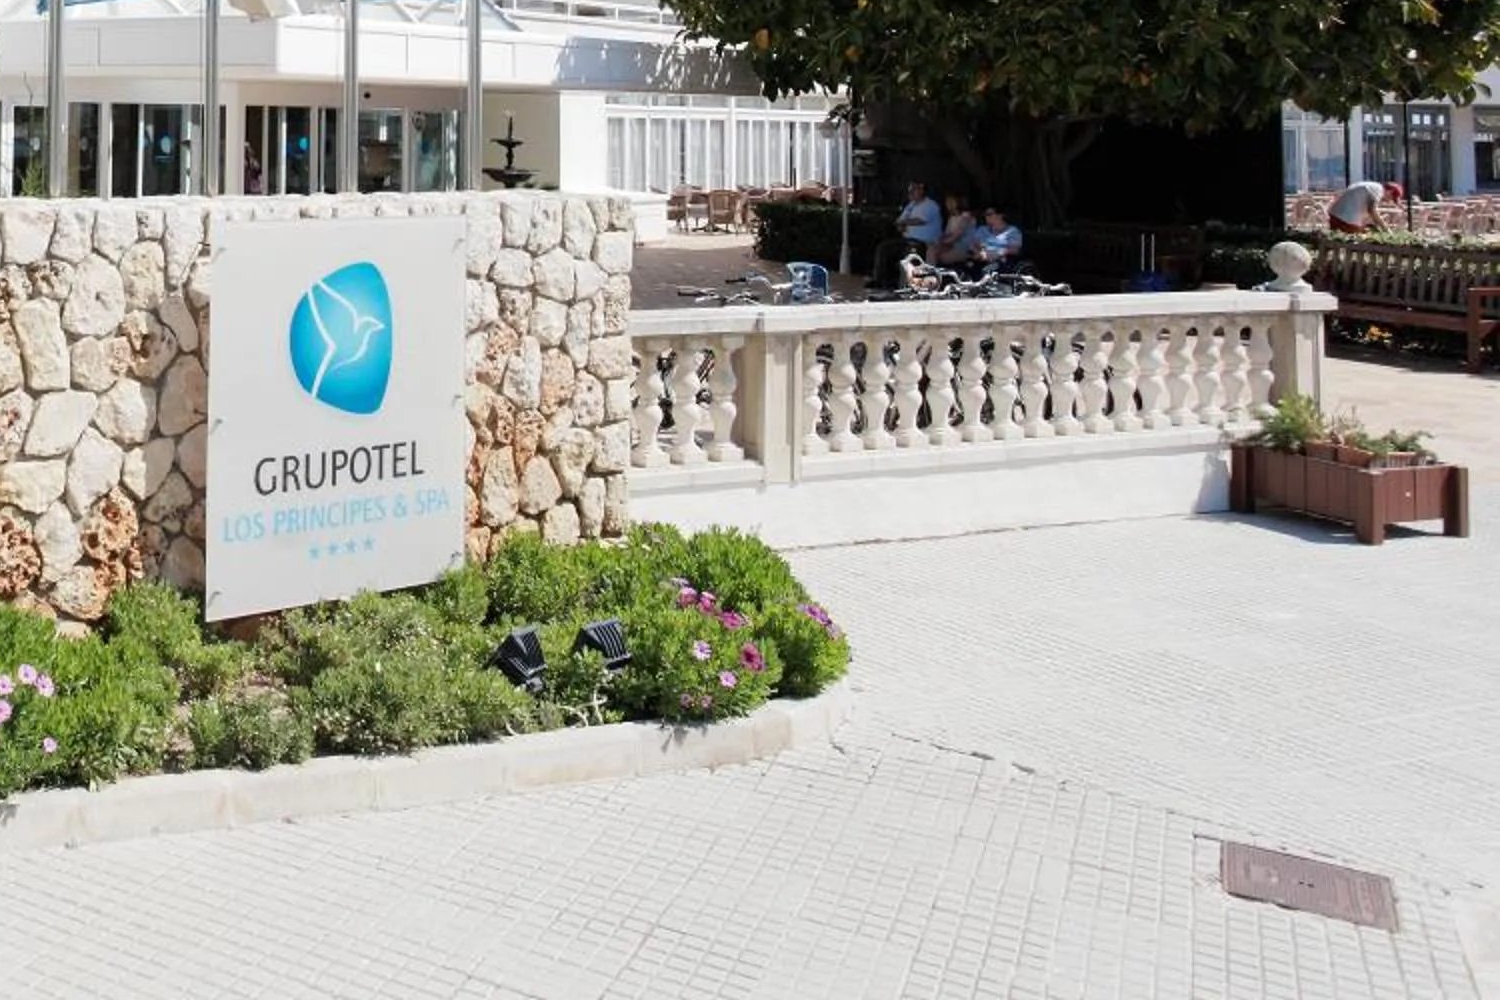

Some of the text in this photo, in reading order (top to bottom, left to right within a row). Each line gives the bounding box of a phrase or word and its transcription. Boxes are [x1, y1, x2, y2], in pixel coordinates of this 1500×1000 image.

[254, 441, 424, 496] GRUPOTEL
[223, 488, 450, 543] LOS PRINCIPES & SPA
